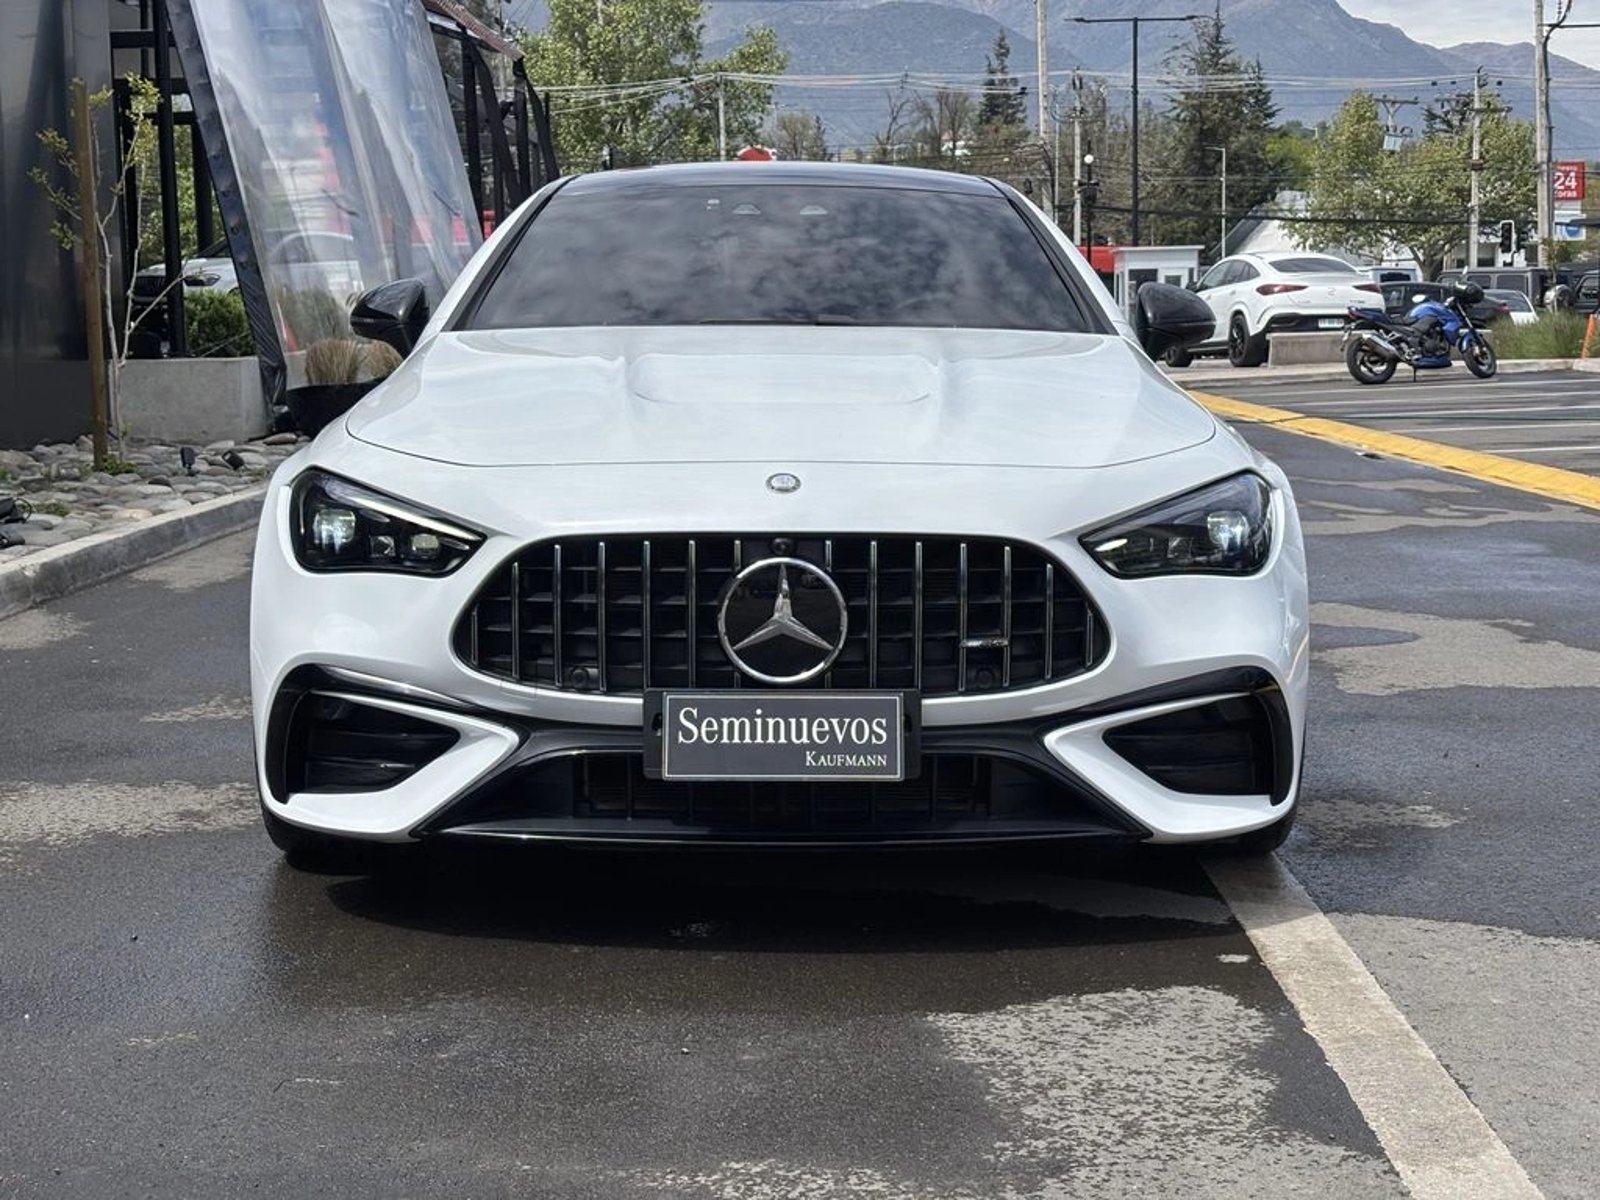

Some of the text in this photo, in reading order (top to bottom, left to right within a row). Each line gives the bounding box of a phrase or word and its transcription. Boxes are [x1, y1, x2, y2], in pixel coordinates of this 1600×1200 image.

[1554, 171, 1578, 189] 24
[678, 707, 887, 744] Seminuevos
[806, 751, 887, 767] KAUFMANN
